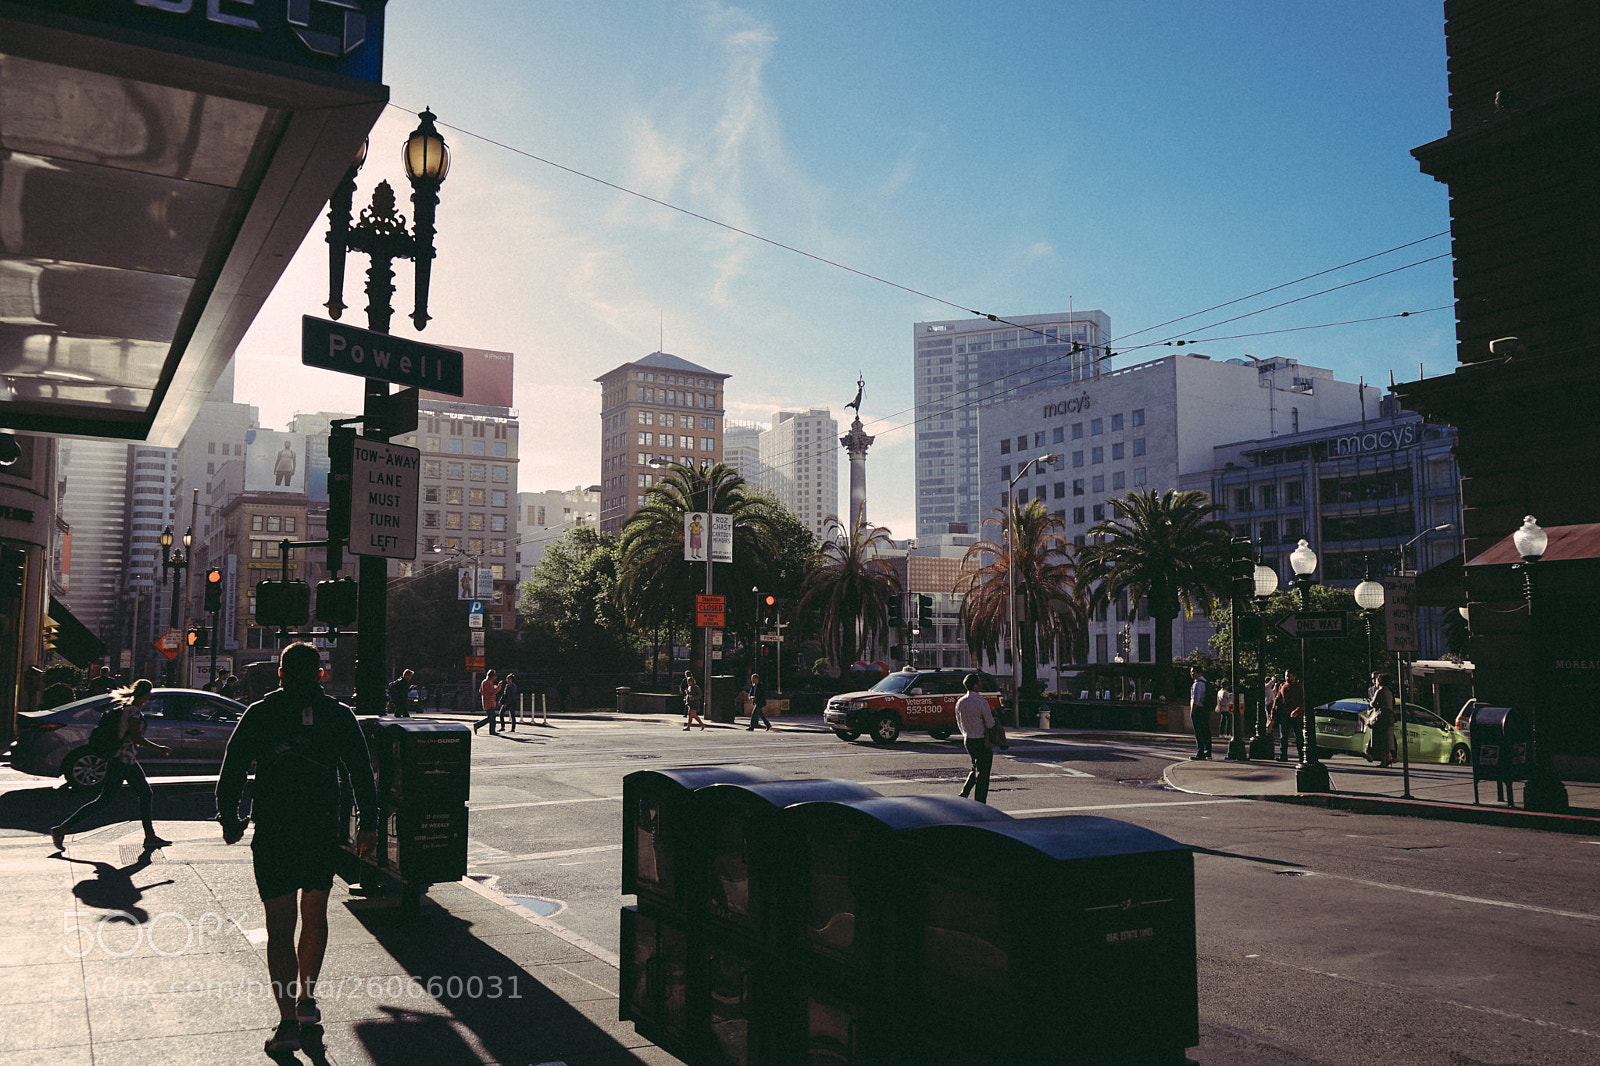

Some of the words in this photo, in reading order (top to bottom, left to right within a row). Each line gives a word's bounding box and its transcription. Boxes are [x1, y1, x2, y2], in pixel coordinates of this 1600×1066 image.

[329, 333, 442, 381] Powell
[354, 447, 418, 470] TOW-AWAY
[368, 470, 402, 487] LANE
[368, 493, 401, 508] MUST
[369, 513, 400, 529] TURN
[715, 516, 729, 524] ROZ
[712, 523, 732, 531] CHAST
[370, 534, 399, 549] LEFT
[1392, 595, 1409, 605] LANE
[471, 601, 482, 613] P
[698, 604, 723, 612] CLOSED
[1393, 609, 1409, 618] MUST
[1296, 620, 1316, 630] ONE
[1318, 619, 1339, 629] WAY
[1393, 623, 1410, 632] TURN
[905, 698, 933, 706] Veterans
[906, 705, 943, 714] 552-1300
